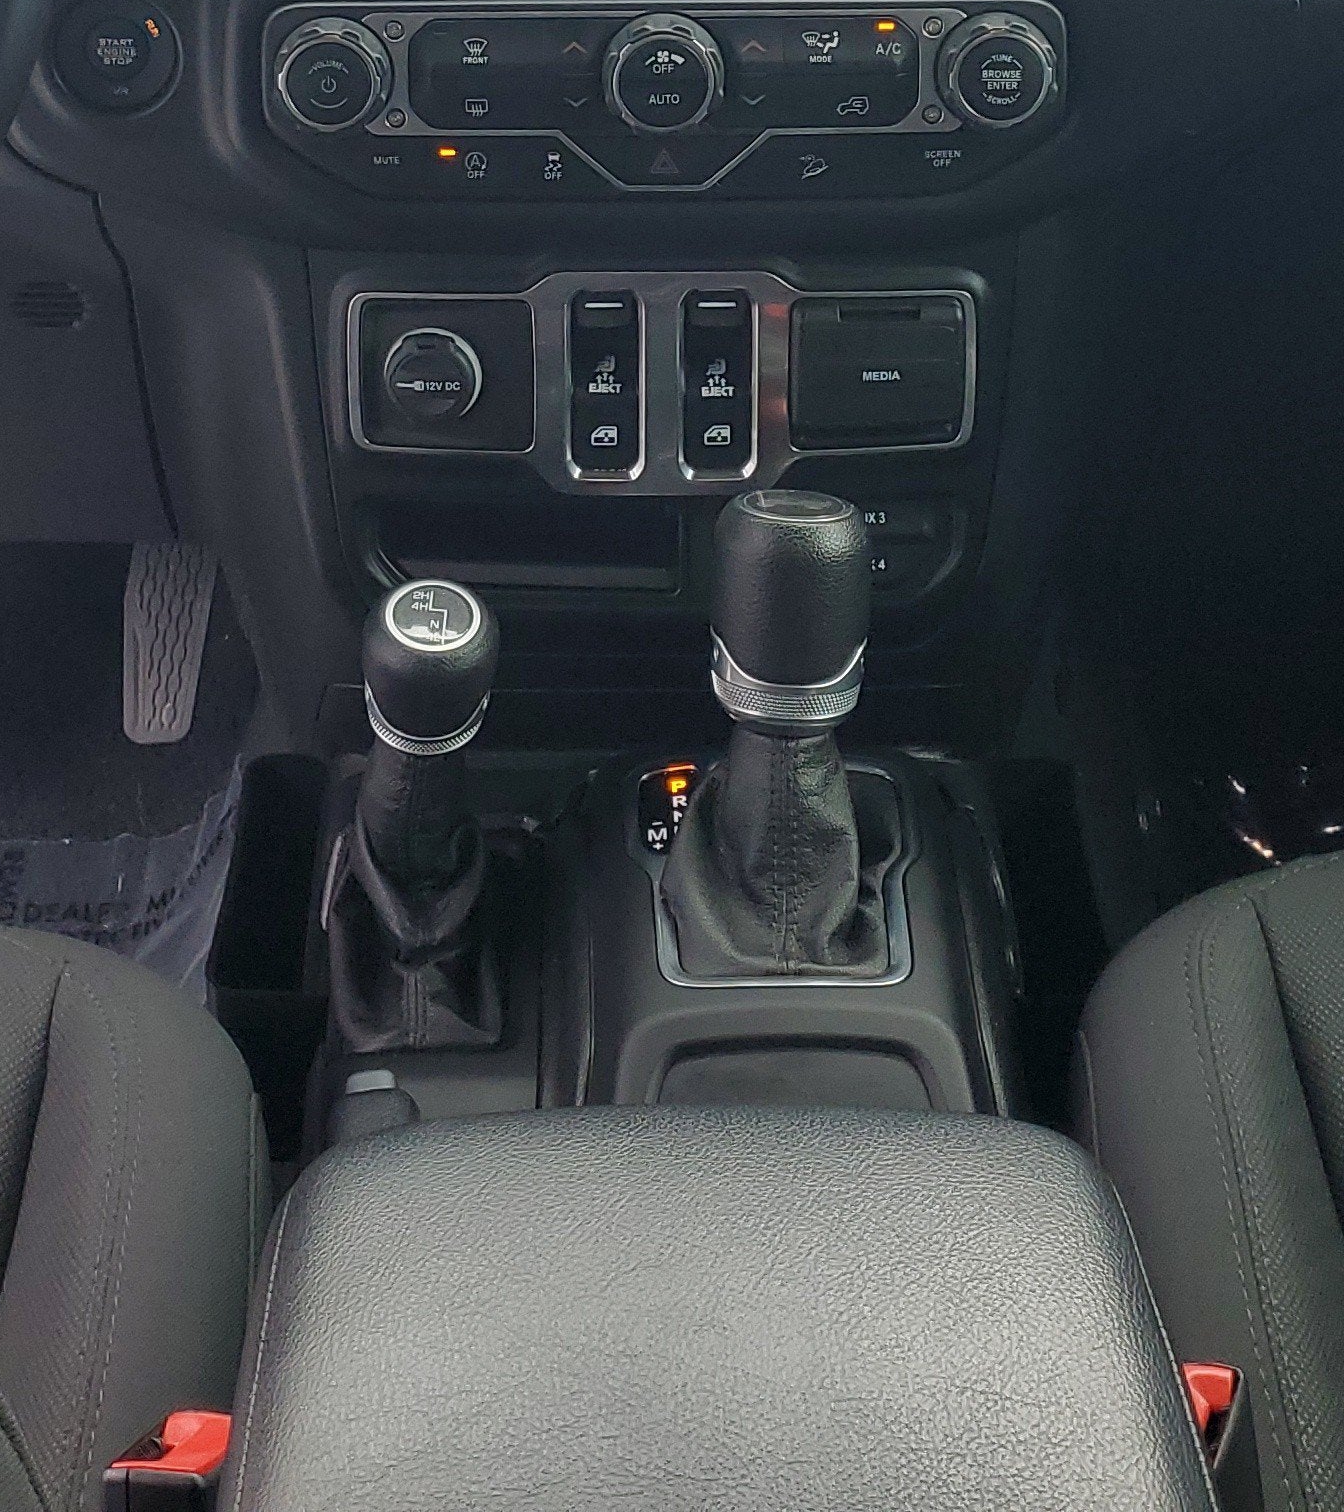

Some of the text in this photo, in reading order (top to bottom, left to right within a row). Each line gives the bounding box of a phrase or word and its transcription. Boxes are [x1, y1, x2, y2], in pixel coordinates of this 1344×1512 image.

[98, 38, 134, 47] START
[875, 41, 901, 56] A/C
[463, 55, 489, 64] FRONT
[809, 54, 833, 64] MODE
[991, 54, 1014, 63] TUNE
[652, 62, 675, 74] OFF
[981, 70, 1022, 79] BROWSE
[987, 81, 1019, 90] ENTER
[649, 93, 680, 105] AUTO
[986, 94, 1018, 105] SCROLL
[924, 149, 962, 159] SCREEN
[373, 154, 401, 165] MUTE
[932, 159, 951, 168] OFF
[467, 169, 486, 179] OFF
[544, 171, 563, 181] OFF
[862, 370, 901, 381] MEDIA
[424, 381, 461, 391] 12V DC
[878, 512, 886, 524] 3
[877, 558, 886, 570] 4
[412, 591, 430, 600] 2H
[411, 601, 429, 611] 4H
[430, 619, 440, 629] N
[670, 779, 687, 793] P
[672, 795, 688, 808] R
[647, 825, 668, 842] M
